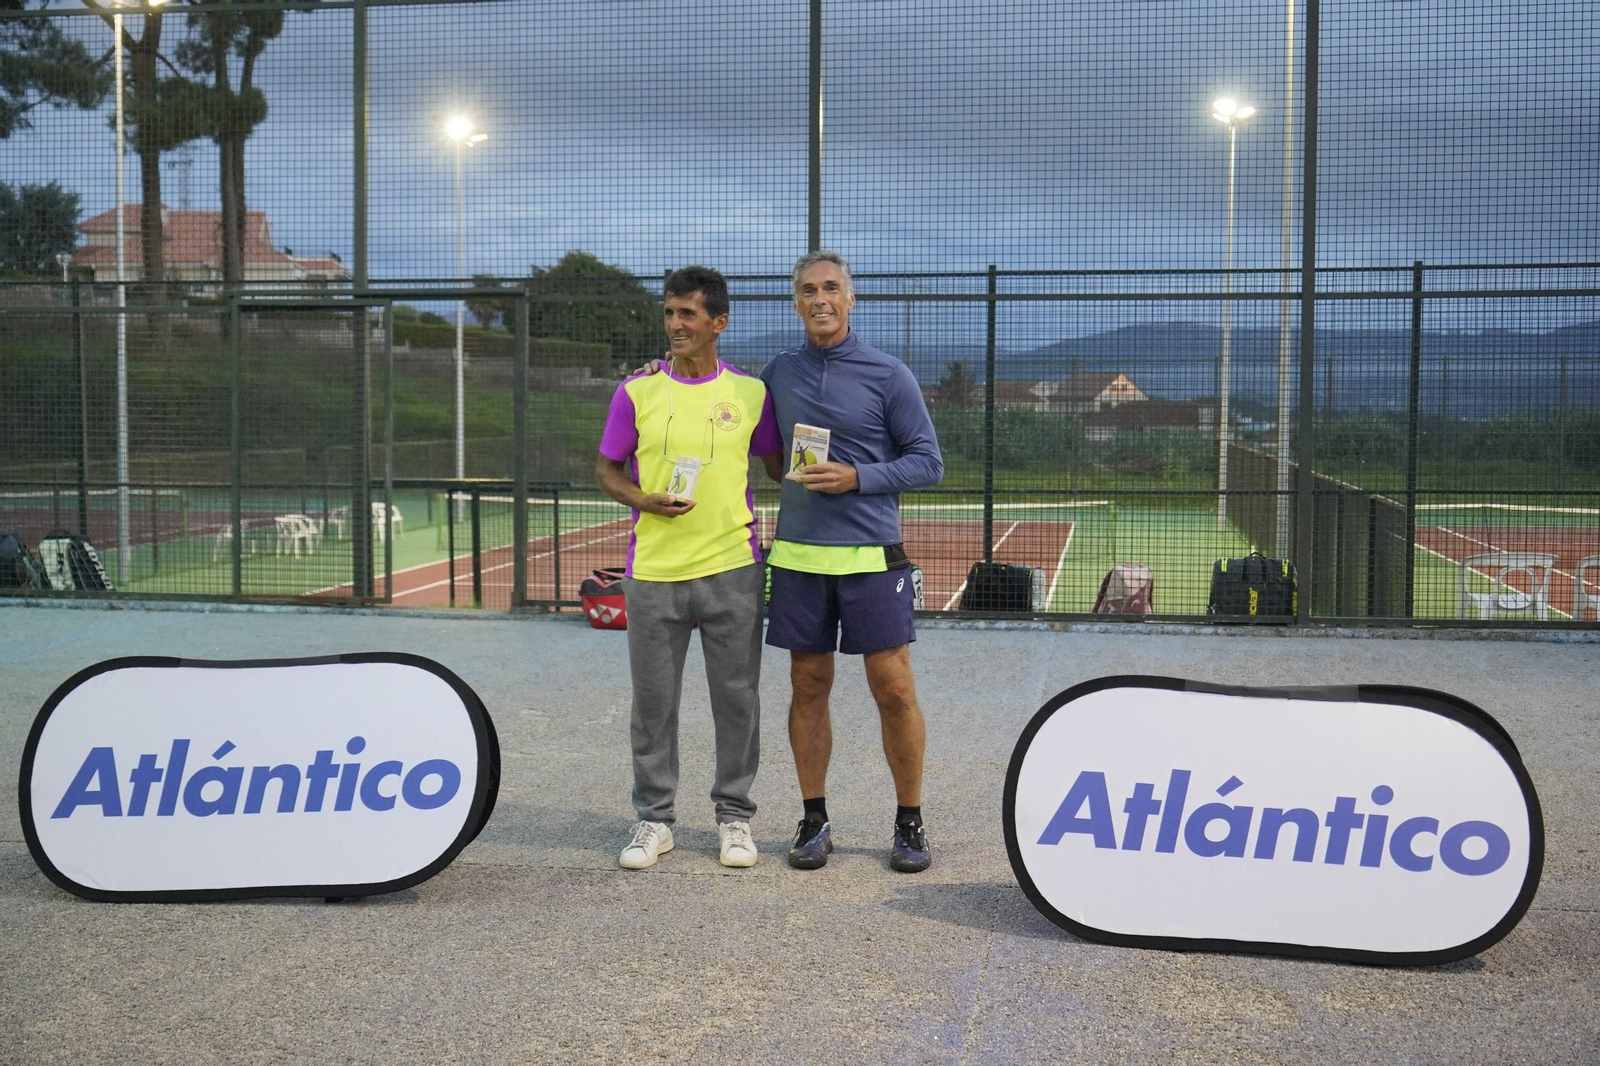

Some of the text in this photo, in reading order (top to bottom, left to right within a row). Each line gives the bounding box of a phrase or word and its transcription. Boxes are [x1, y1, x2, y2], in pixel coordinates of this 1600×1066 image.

[83, 541, 113, 591] UNLOP
[50, 736, 461, 819] Atlántico
[1037, 769, 1510, 876] Atlántico
